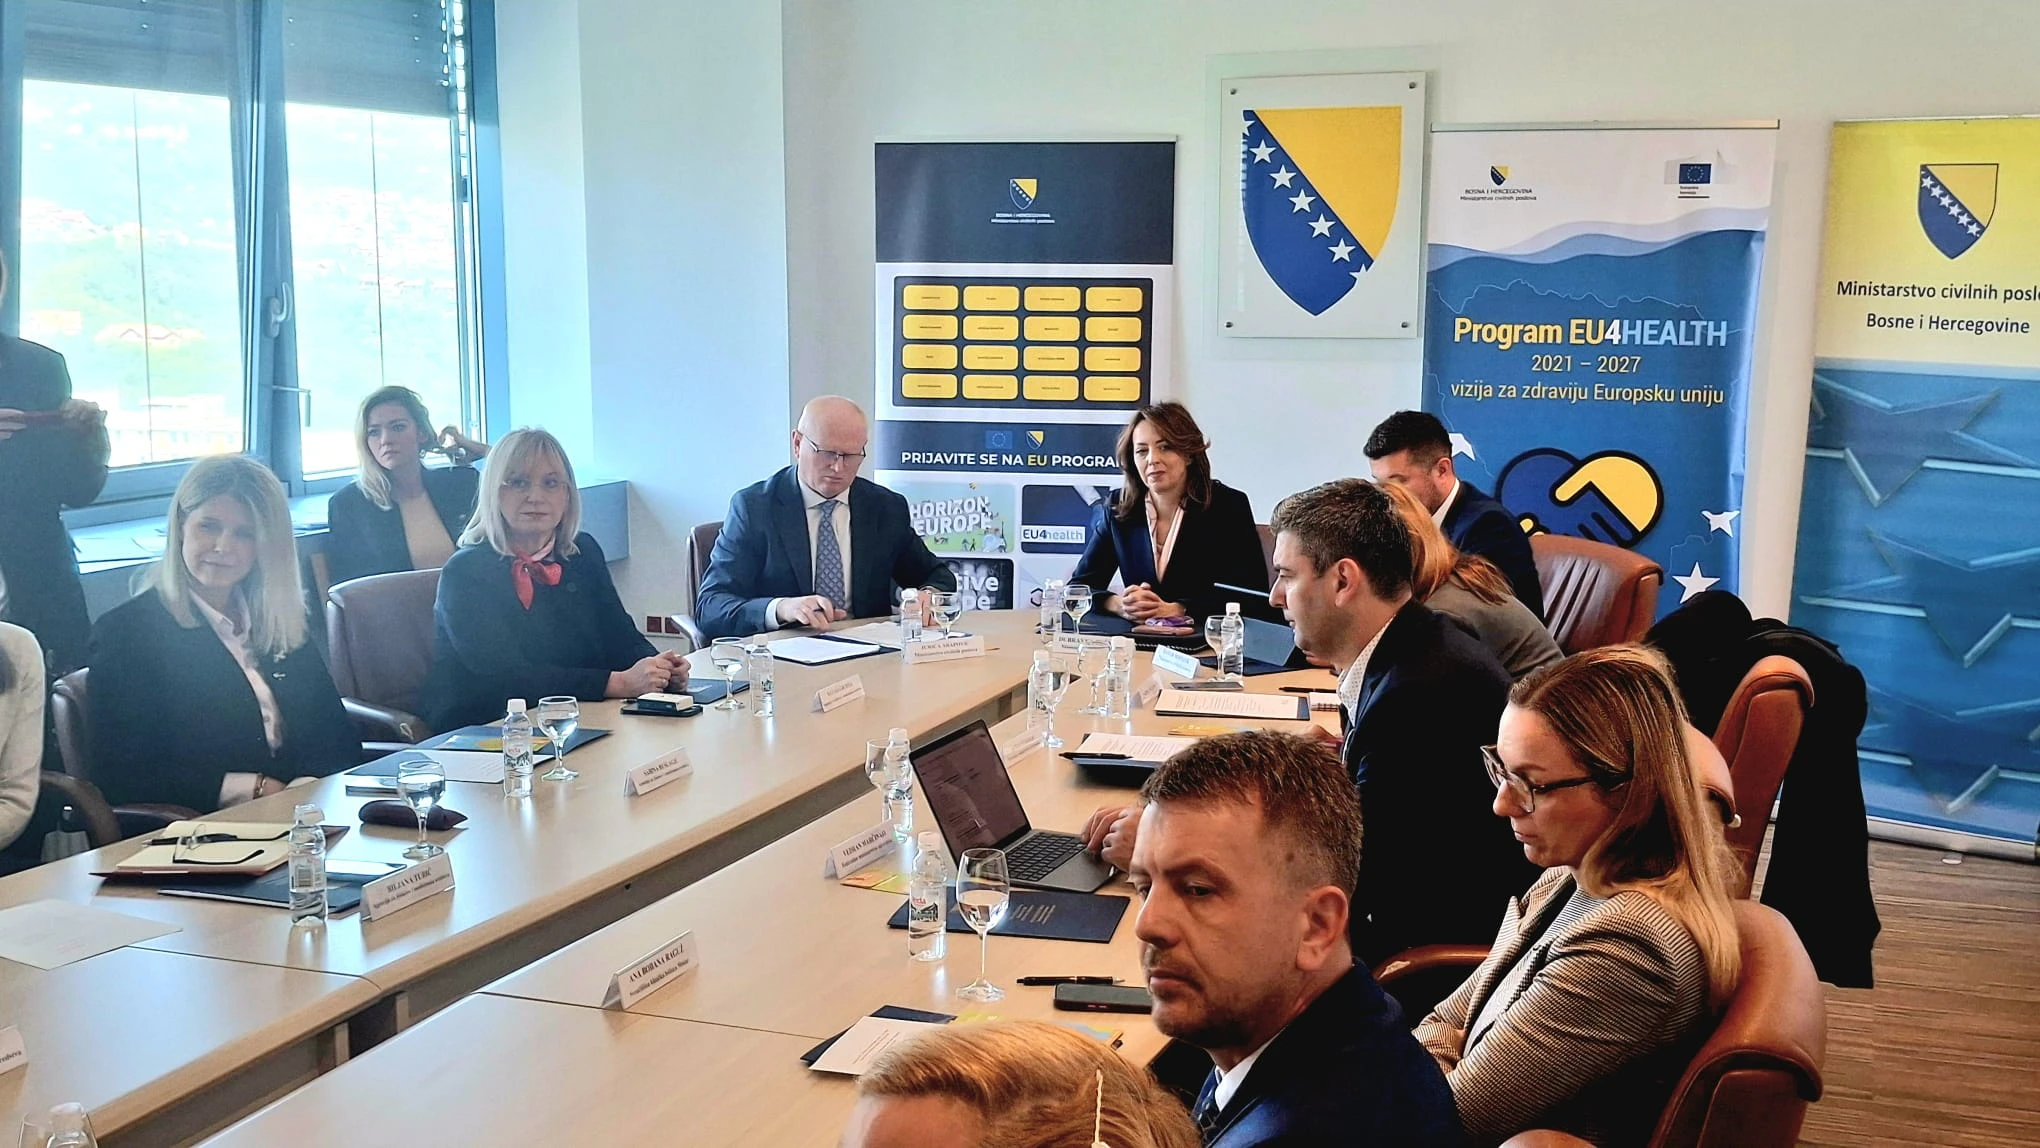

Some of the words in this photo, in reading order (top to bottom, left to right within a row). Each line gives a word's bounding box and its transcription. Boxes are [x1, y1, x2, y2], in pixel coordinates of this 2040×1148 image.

[1837, 281, 1936, 299] Ministarstvo
[1941, 283, 1998, 301] civilnih
[2003, 285, 2040, 304] posl
[1454, 317, 1562, 350] Program
[1569, 318, 1727, 347] EU4HEALTH
[1866, 313, 1914, 329] Bosne
[1919, 314, 1923, 329] i
[1928, 315, 2030, 336] Hercegovine
[1531, 355, 1572, 372] 2021
[1597, 356, 1642, 373] 2027
[1451, 380, 1493, 398] vizija
[1498, 385, 1517, 398] za
[1522, 381, 1588, 404] zdraviju
[1594, 384, 1676, 405] Europsku
[1681, 387, 1724, 407] uniju
[901, 451, 975, 466] PRIJAVITE
[979, 453, 998, 466] SE
[1002, 453, 1024, 467] NA
[1027, 454, 1047, 467] EU
[910, 496, 990, 518] HORIZON
[912, 512, 992, 537] EUROPE
